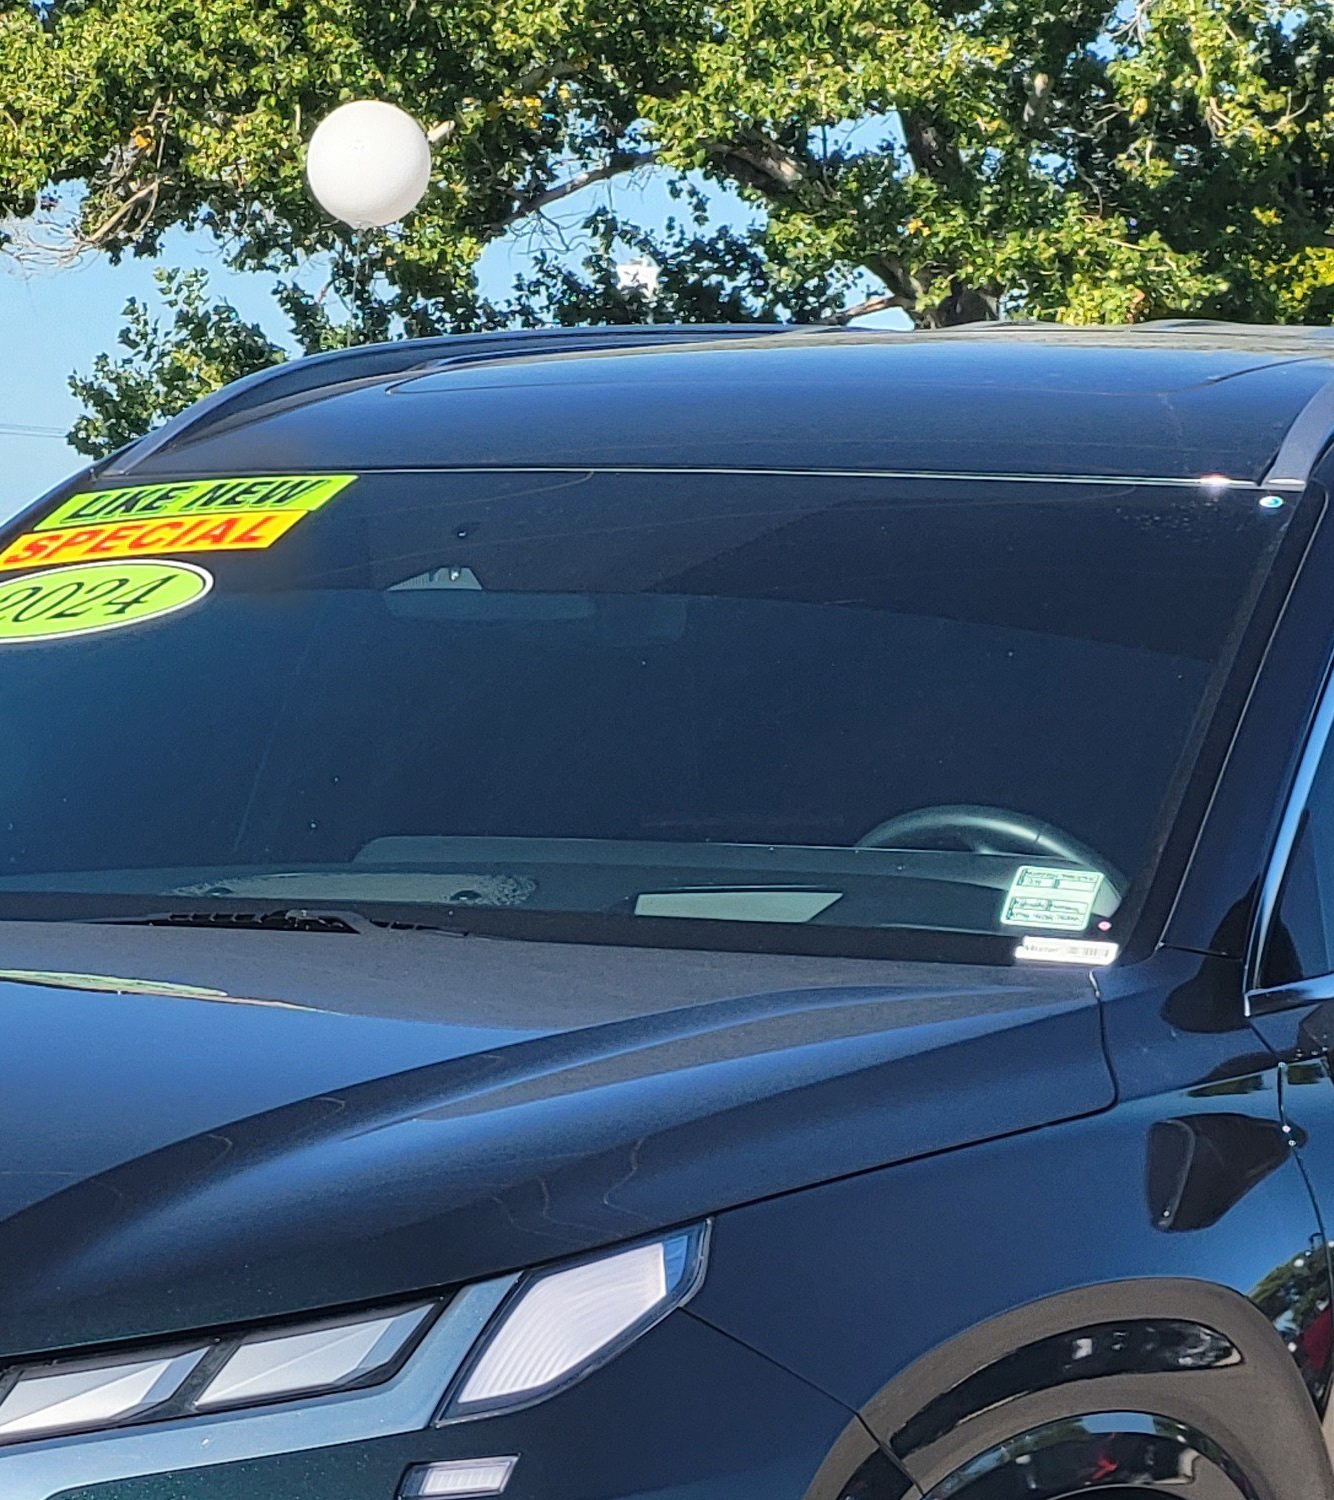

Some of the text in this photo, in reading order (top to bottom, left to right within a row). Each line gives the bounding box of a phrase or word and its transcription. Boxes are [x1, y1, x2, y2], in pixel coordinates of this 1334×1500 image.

[61, 479, 331, 523] LIKE NEW
[3, 515, 275, 564] SPECIAL
